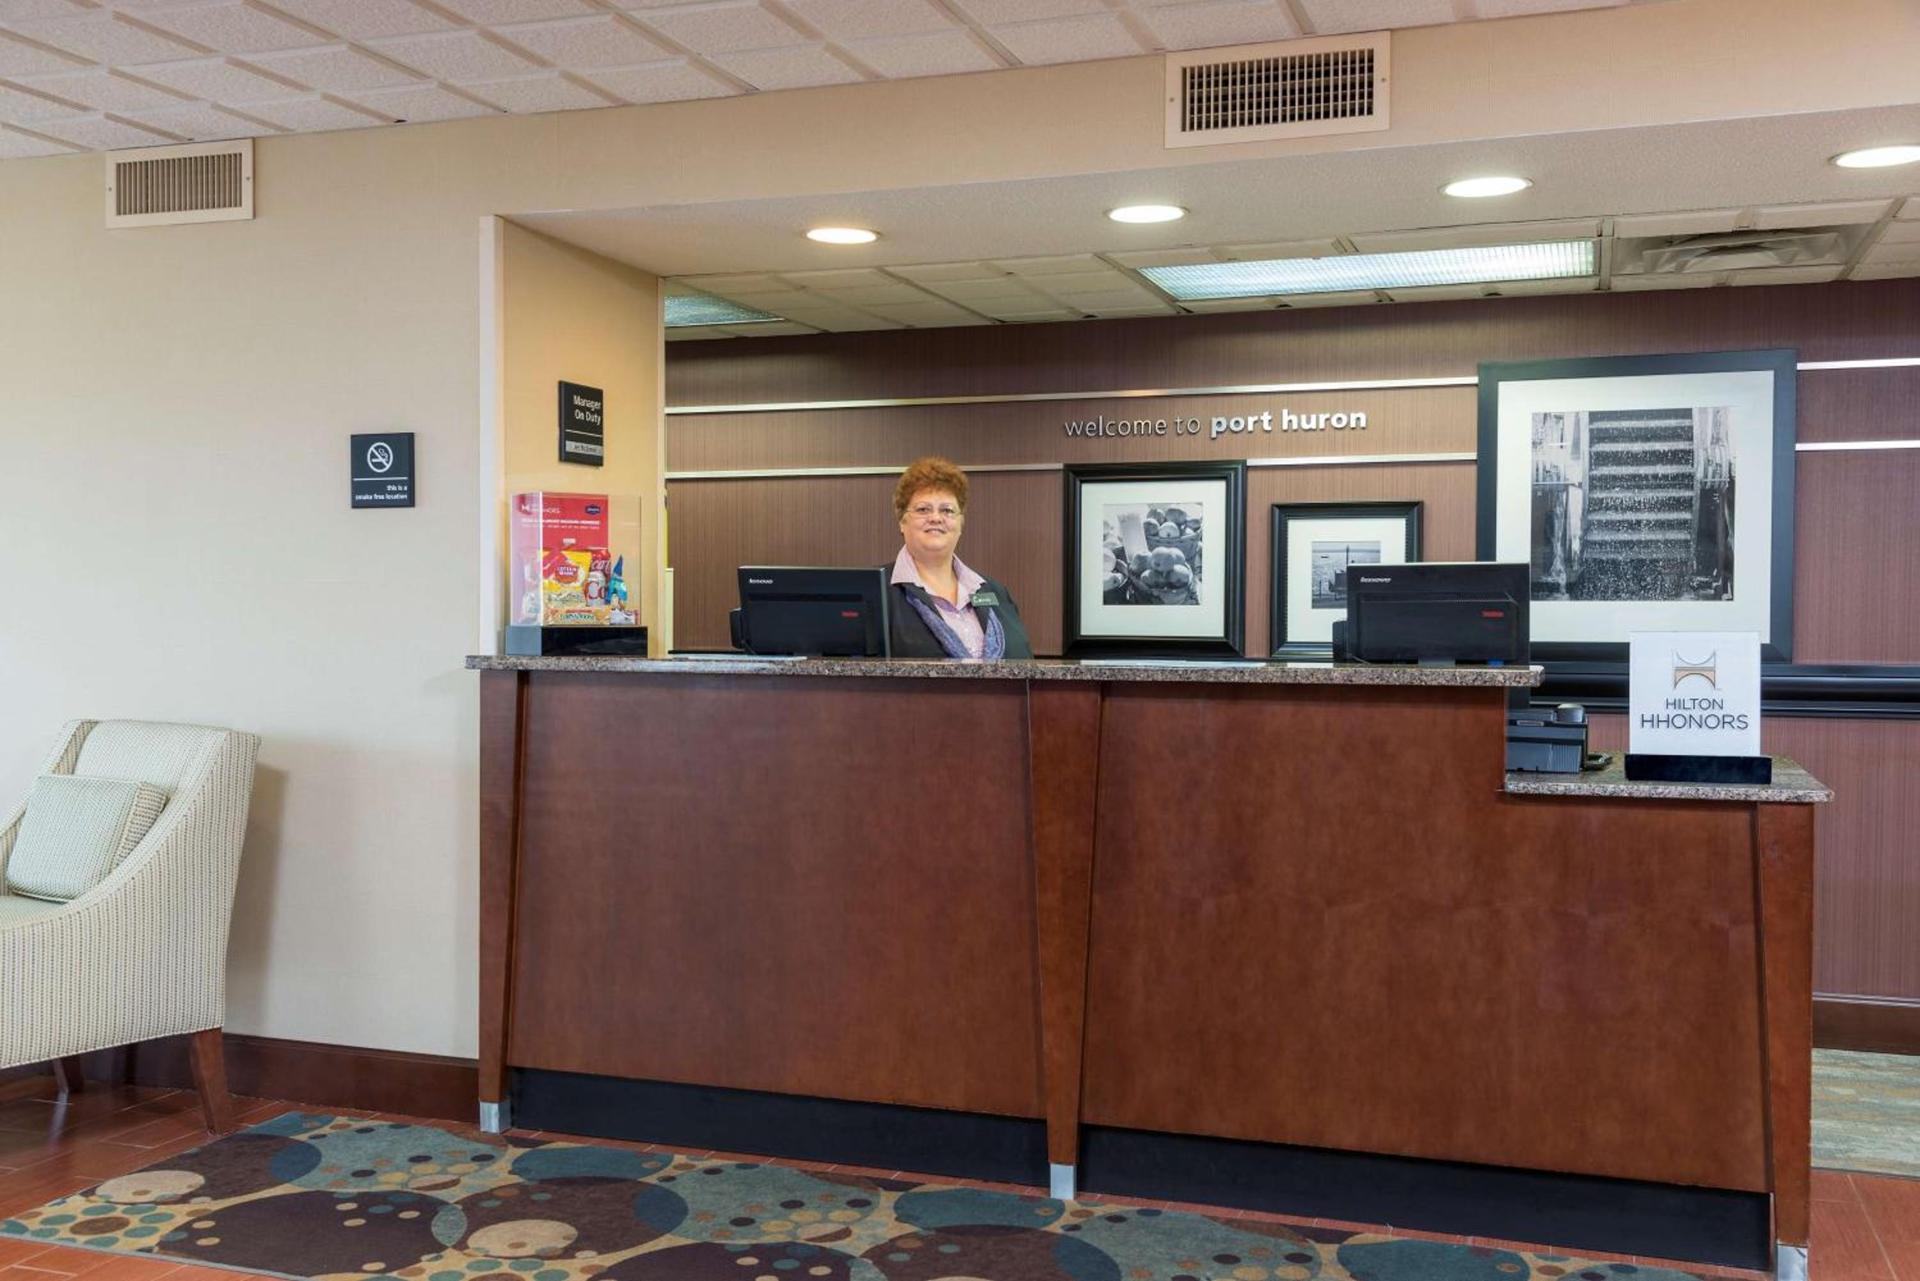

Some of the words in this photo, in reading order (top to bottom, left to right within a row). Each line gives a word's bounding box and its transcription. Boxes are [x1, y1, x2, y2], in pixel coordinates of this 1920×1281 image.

[573, 394, 602, 411] Manager
[574, 409, 584, 421] On
[585, 411, 602, 426] Duty
[1064, 416, 1167, 437] welcome
[1174, 415, 1201, 435] to
[1211, 410, 1273, 439] port
[1281, 409, 1367, 432] huron
[749, 577, 774, 585] lenovo
[1360, 576, 1392, 584] lenovo
[1665, 697, 1724, 711] HILTON
[1640, 713, 1750, 730] HHONORS
